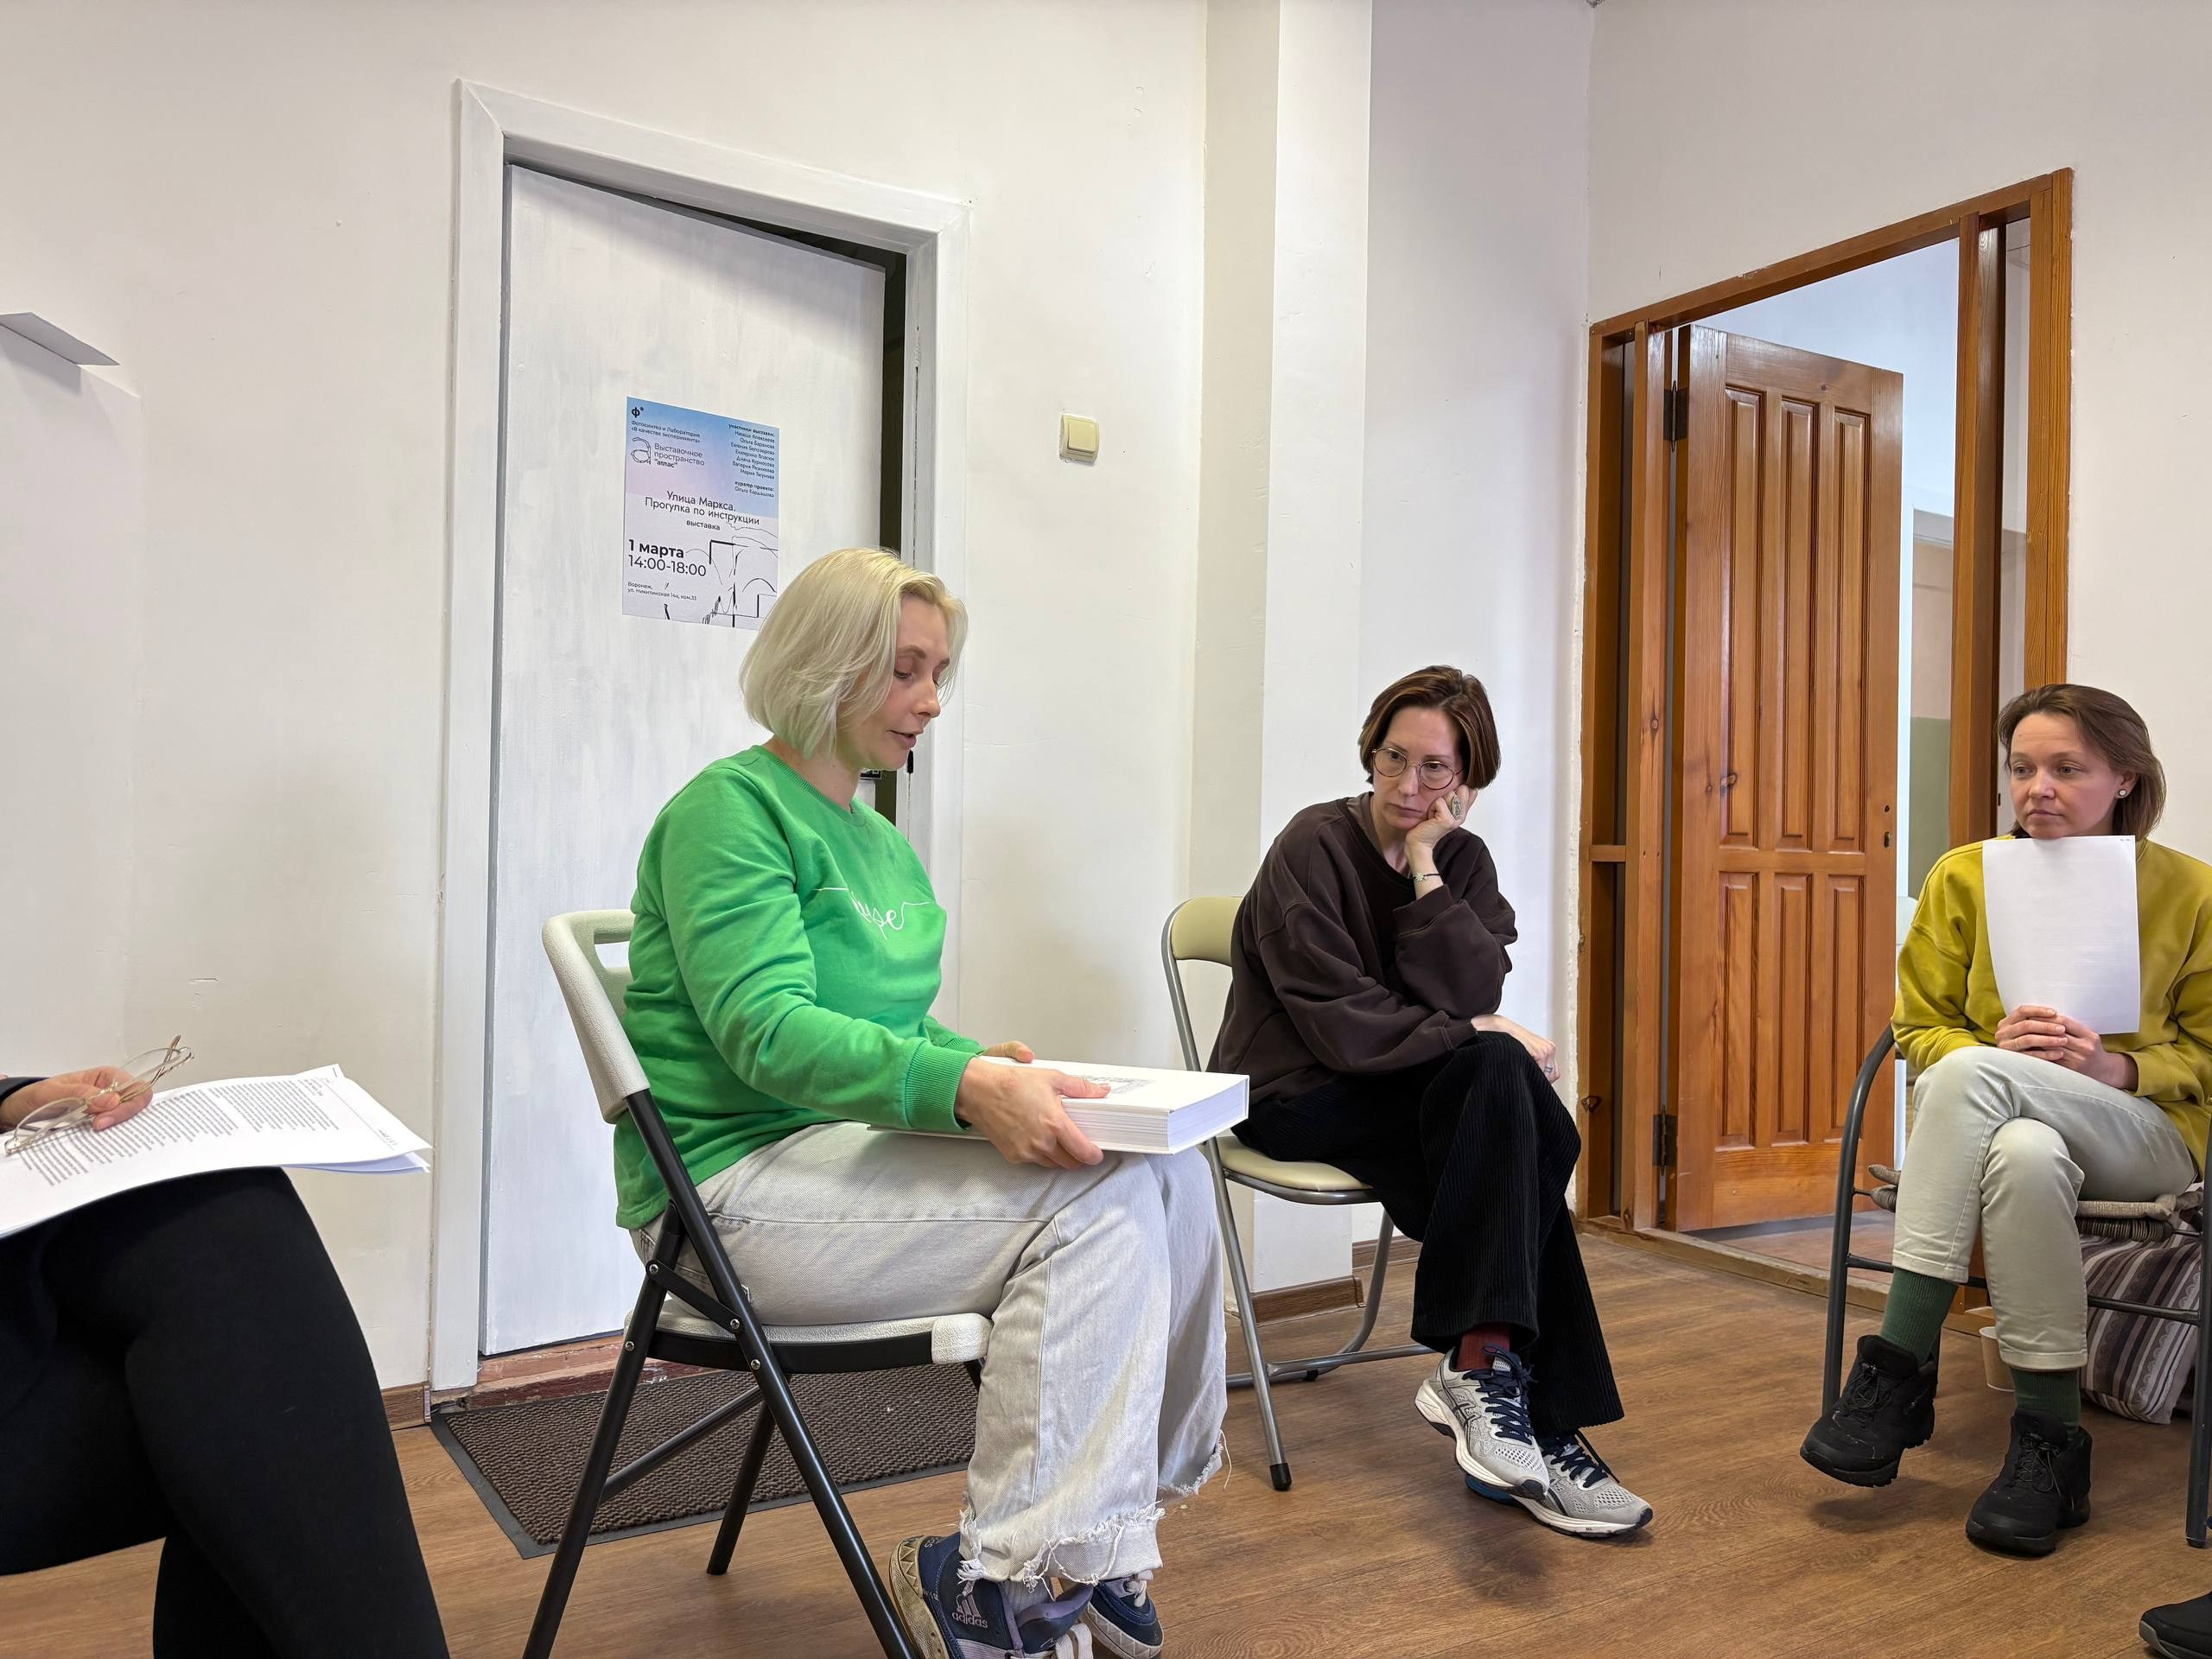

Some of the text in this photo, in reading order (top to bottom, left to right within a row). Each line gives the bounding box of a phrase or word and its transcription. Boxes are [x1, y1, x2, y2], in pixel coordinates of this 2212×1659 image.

[632, 421, 662, 430] Фотосинтез
[666, 428, 700, 437] Лаборатория
[654, 442, 702, 458] Выставочное
[654, 452, 705, 466] пространство
[666, 490, 736, 512] Улица Маркса.
[645, 497, 690, 513] Прогулка
[709, 510, 760, 525] инструкции
[686, 520, 721, 531] выставка
[628, 539, 684, 558] 1 марта
[628, 554, 707, 576] 14:00-18:00
[627, 581, 653, 589] Воронеж,
[951, 1611, 988, 1629] adidas
